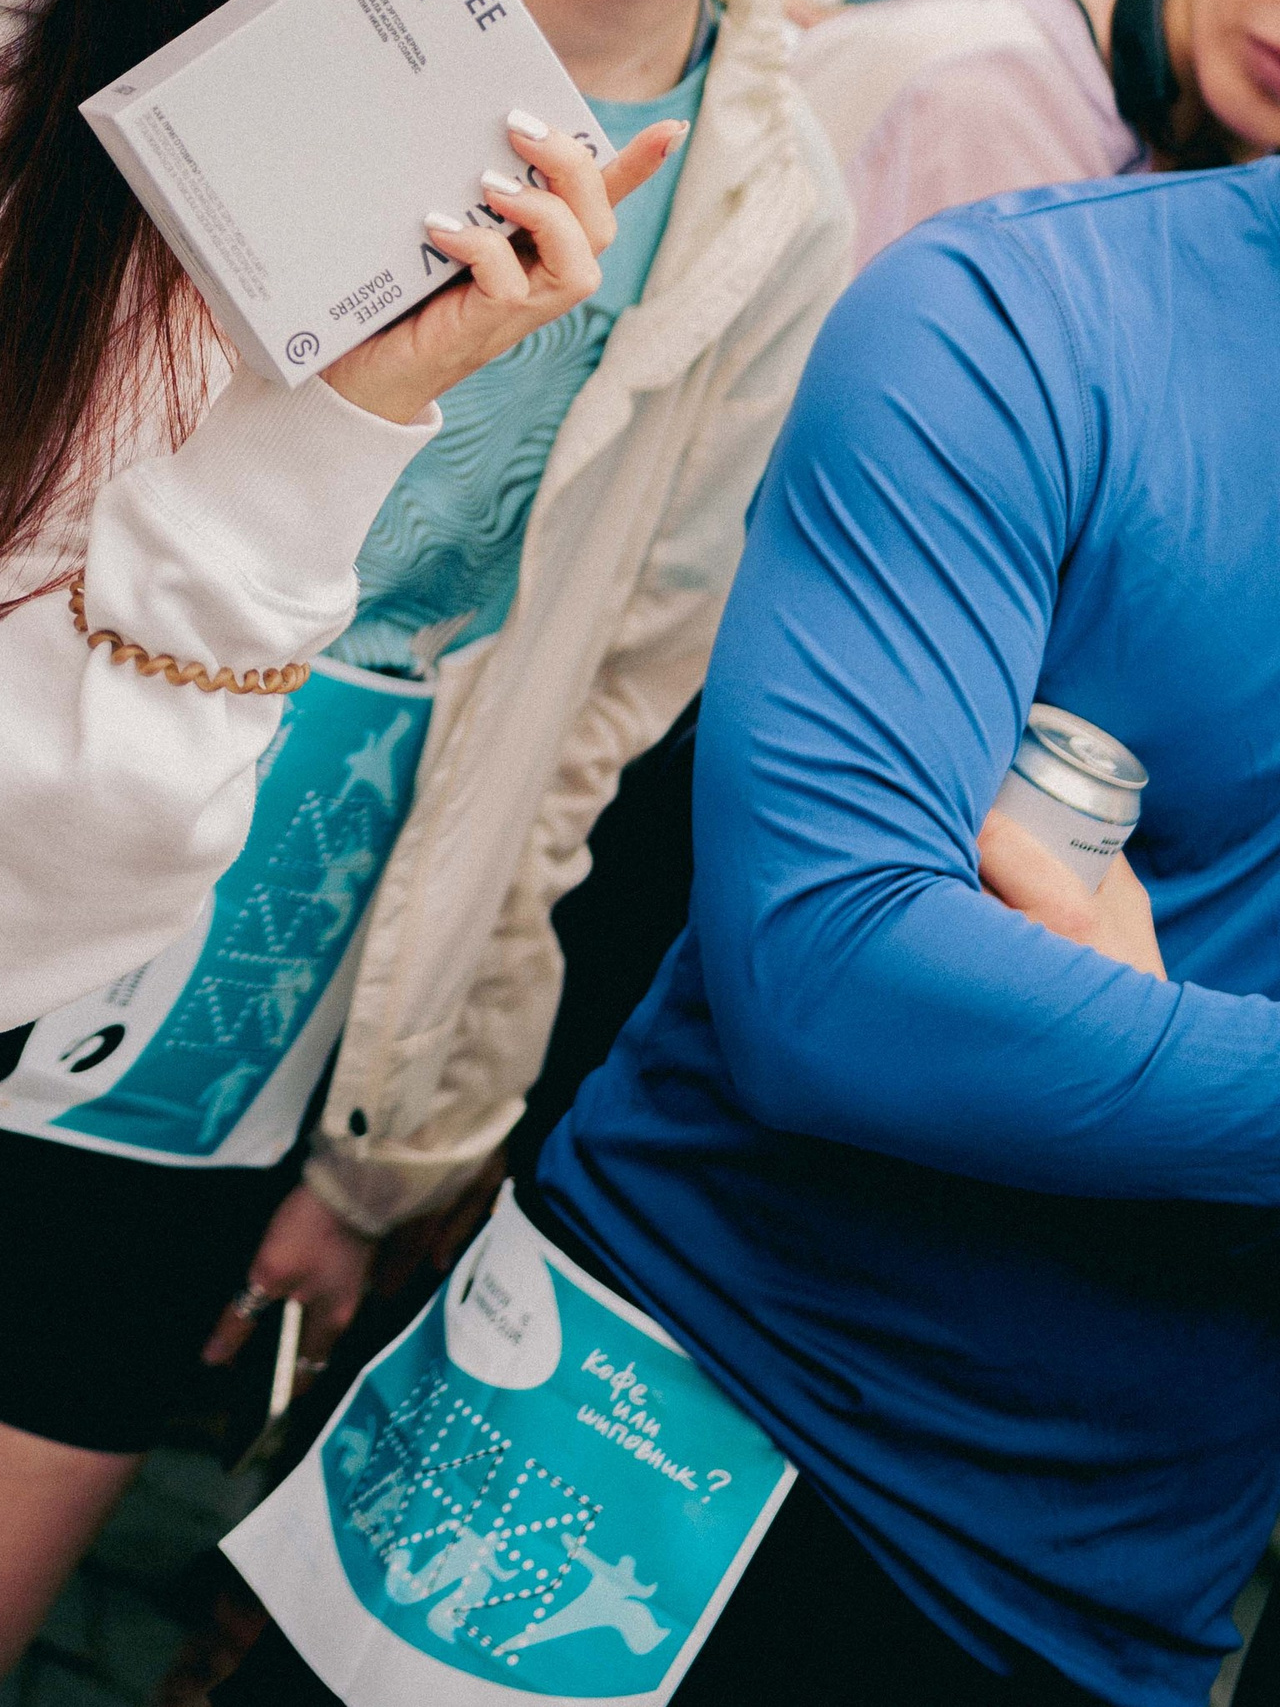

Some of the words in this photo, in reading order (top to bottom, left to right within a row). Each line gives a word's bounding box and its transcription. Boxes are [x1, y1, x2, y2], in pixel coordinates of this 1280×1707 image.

[329, 269, 394, 320] ROASTERS
[354, 285, 402, 325] COFFEE
[581, 1348, 648, 1406] Кофе
[612, 1400, 661, 1438] или
